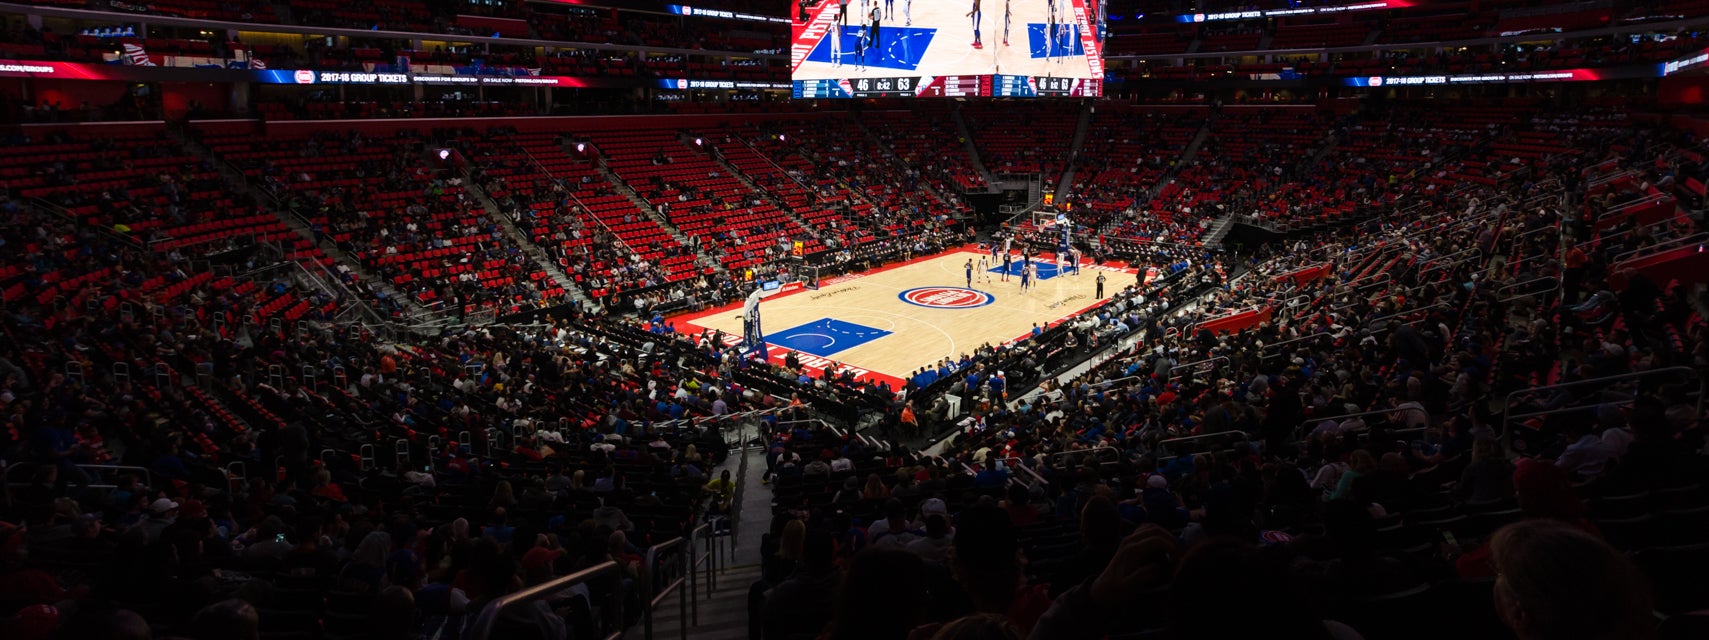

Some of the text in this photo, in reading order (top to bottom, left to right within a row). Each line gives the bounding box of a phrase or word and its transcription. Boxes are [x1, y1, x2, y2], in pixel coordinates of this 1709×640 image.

[1083, 40, 1104, 79] PISTONS
[320, 73, 350, 82] 2017-18
[350, 73, 377, 82] GROUP
[377, 74, 408, 83] TICKETS
[897, 78, 910, 90] 63
[857, 79, 869, 91] 46
[877, 82, 891, 90] 8:42
